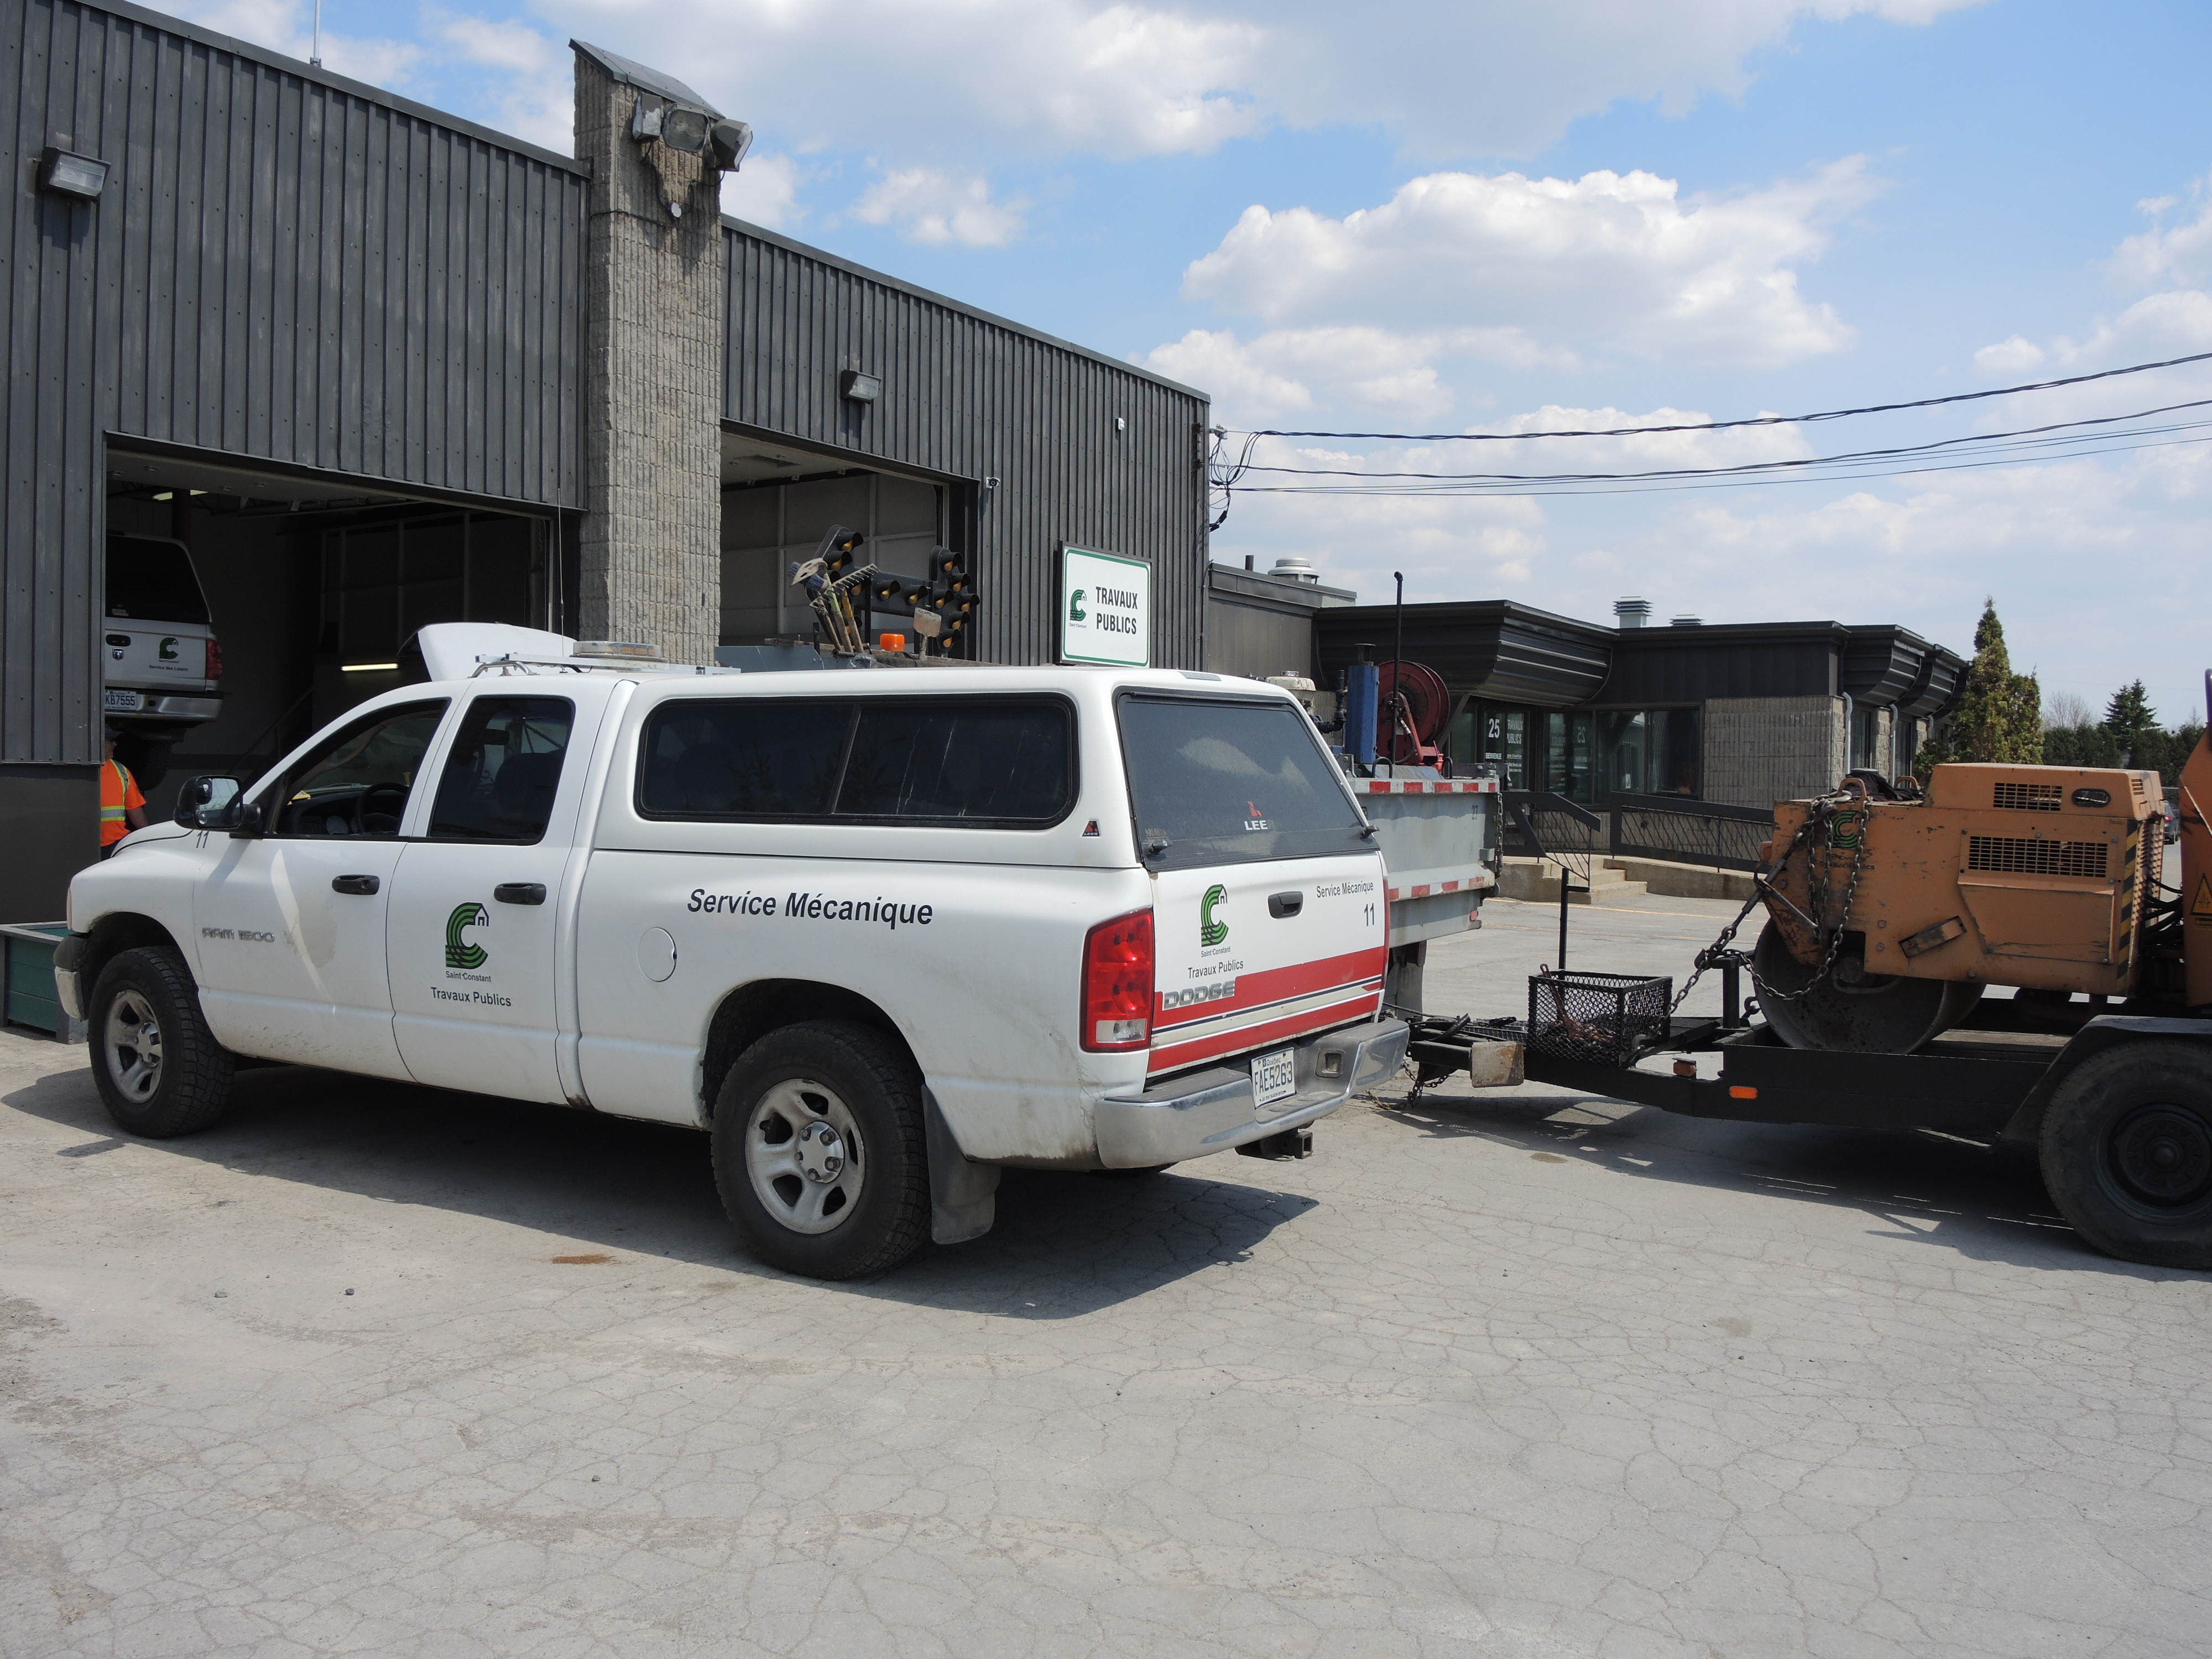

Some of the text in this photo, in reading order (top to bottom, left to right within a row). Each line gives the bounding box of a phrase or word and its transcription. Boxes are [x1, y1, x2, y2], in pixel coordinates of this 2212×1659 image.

[1095, 586, 1138, 609] TRAVAUX
[1096, 613, 1136, 635] PUBLICS
[105, 695, 135, 706] KB7555
[1488, 718, 1500, 738] 25
[196, 830, 210, 848] 11
[1317, 880, 1374, 898] Service Mécanique
[687, 888, 933, 930] Service Mécanique
[1364, 902, 1374, 927] 11
[202, 927, 275, 943] RAM 1500
[1188, 959, 1244, 979] Travaux Publics
[431, 987, 512, 1006] Travaux Publics
[1164, 980, 1235, 1009] DODGE
[1254, 1061, 1293, 1096] FAE5263
